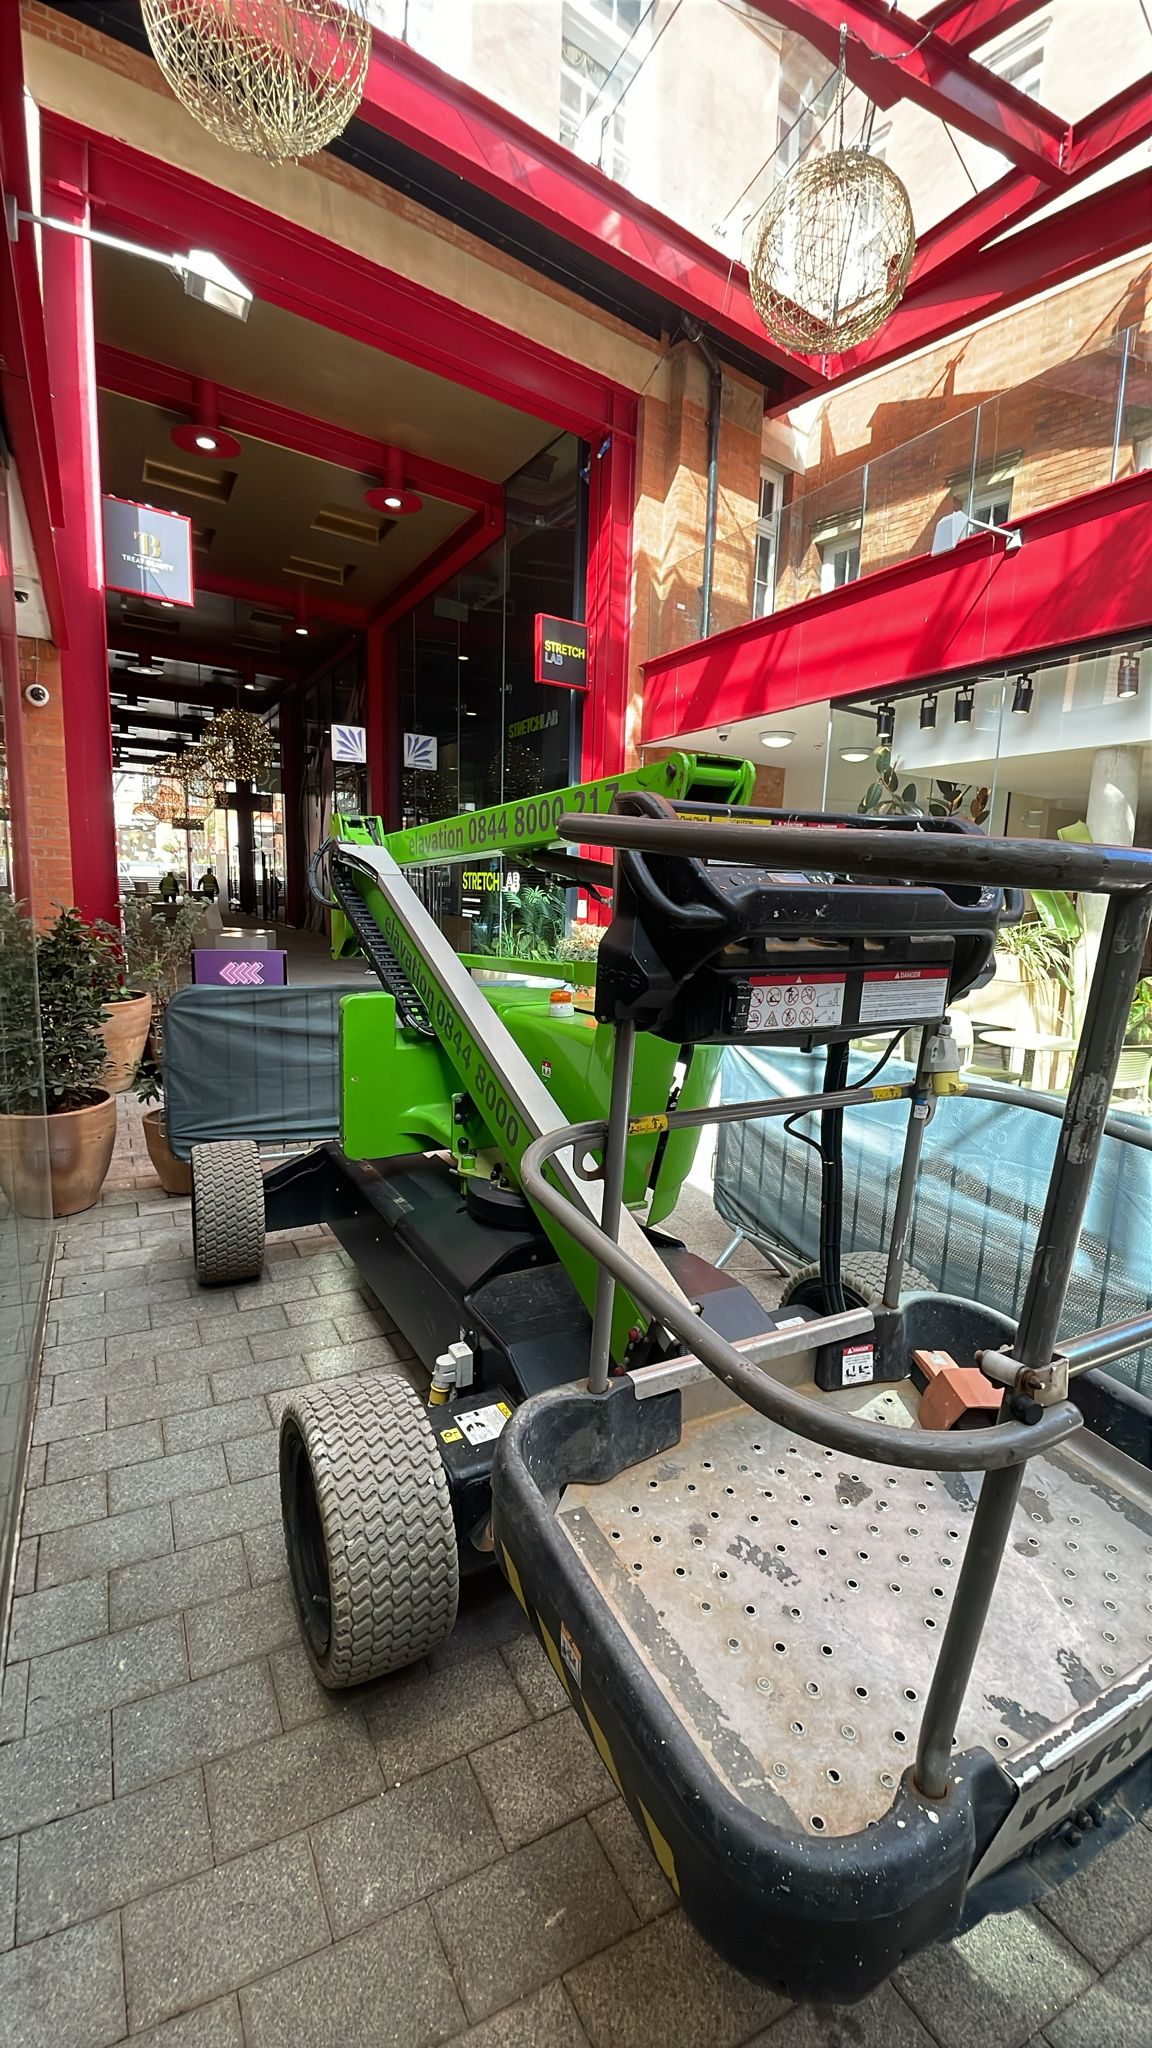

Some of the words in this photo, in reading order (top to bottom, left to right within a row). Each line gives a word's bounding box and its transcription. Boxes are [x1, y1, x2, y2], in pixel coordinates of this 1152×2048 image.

[121, 553, 144, 565] TREAT
[544, 640, 586, 660] STRETCH
[544, 651, 563, 666] LAB
[408, 824, 464, 855] elavation
[468, 810, 508, 845] 0844
[514, 796, 565, 838] 8000
[573, 782, 620, 814] 217
[900, 971, 921, 979] DANGER
[384, 915, 434, 1010] elavation
[436, 1000, 472, 1071] 0844
[475, 1066, 519, 1147] 8000
